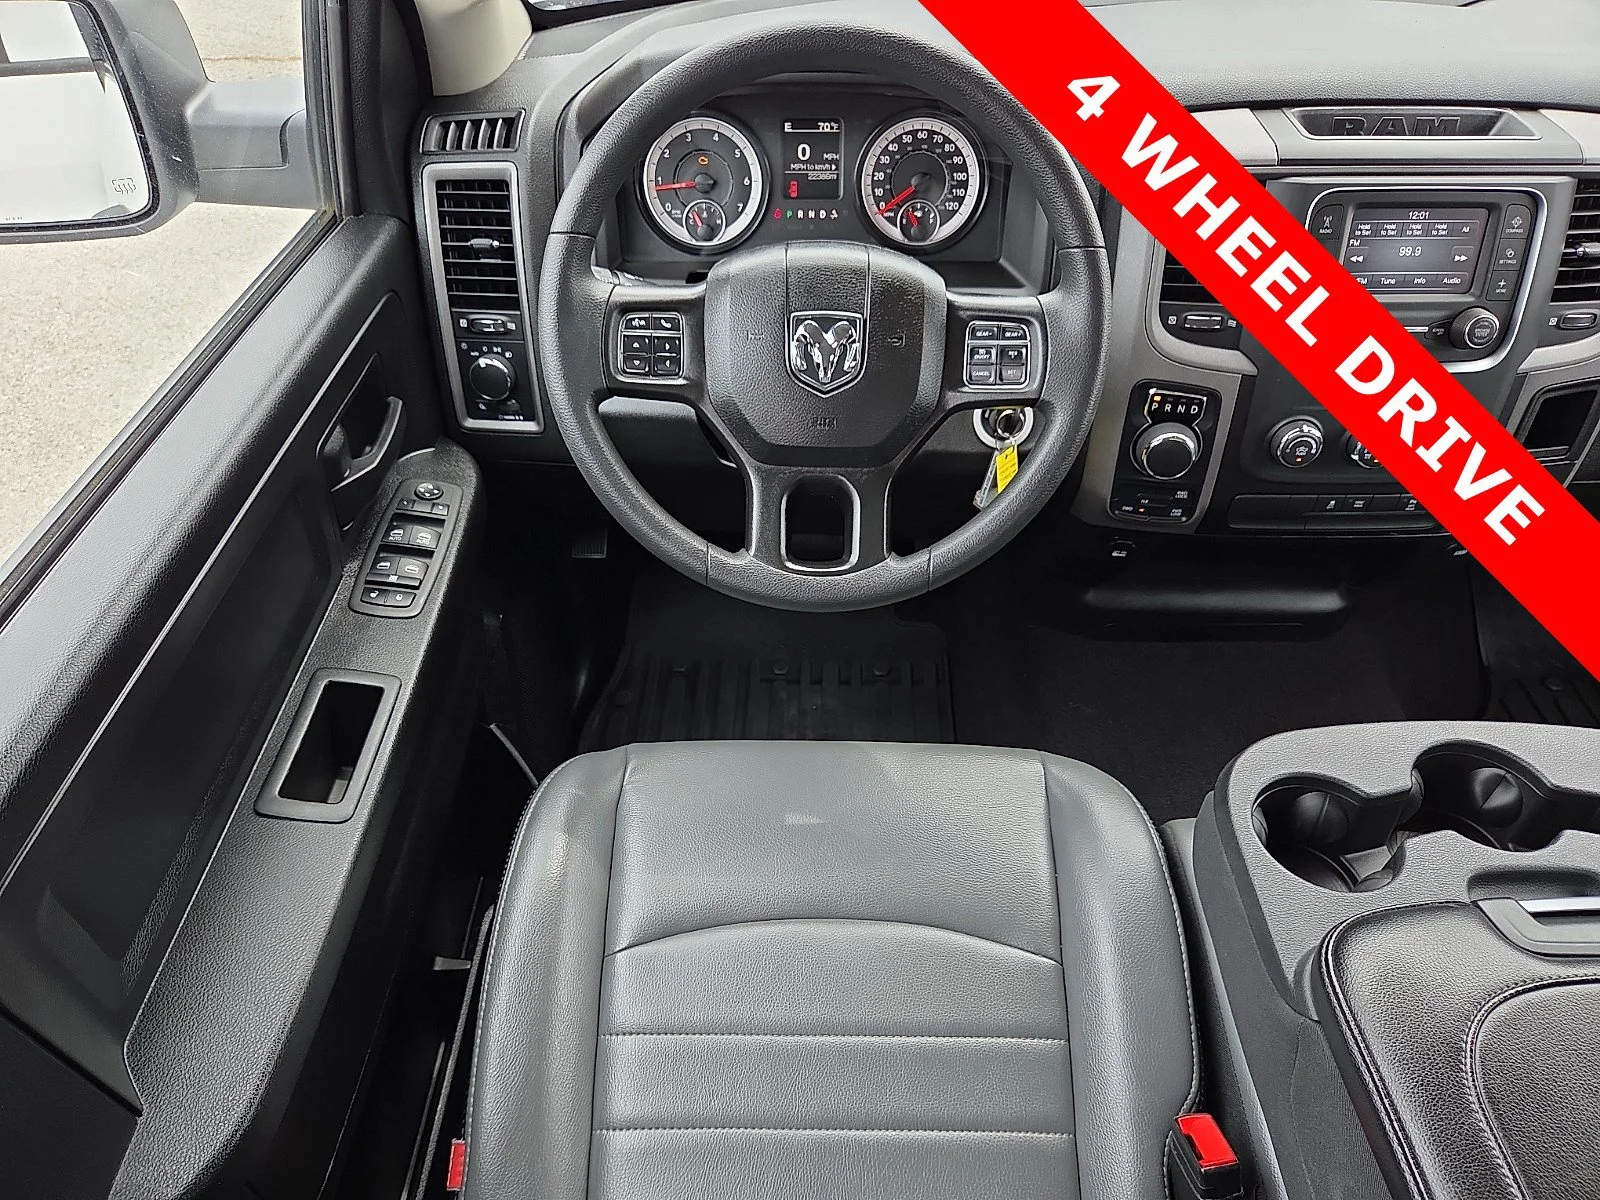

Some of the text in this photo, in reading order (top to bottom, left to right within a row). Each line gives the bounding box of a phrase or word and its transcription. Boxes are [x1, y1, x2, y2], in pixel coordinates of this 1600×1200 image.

[784, 122, 792, 132] E
[1331, 116, 1460, 137] RAM
[685, 133, 692, 142] 3
[712, 133, 719, 142] 4
[902, 134, 913, 143] 50
[917, 130, 928, 139] 60
[932, 134, 943, 144] 70
[797, 143, 840, 161] 0 MPH
[887, 143, 899, 152] 40
[944, 143, 956, 152] 80
[663, 149, 670, 158] 2
[734, 149, 741, 158] 5
[879, 155, 890, 164] 30
[952, 156, 963, 164] 90
[790, 163, 831, 171] MPH to km/h
[657, 176, 662, 184] 1
[873, 172, 885, 180] 20
[953, 172, 967, 181] 100
[743, 176, 750, 186] 6
[874, 188, 883, 197] 10
[952, 188, 965, 197] 110
[665, 202, 672, 212] 0
[737, 203, 743, 212] 7
[879, 201, 885, 210] 0
[945, 202, 959, 211] 120
[786, 209, 827, 219] P R N D
[1408, 211, 1430, 220] 12:01
[1398, 246, 1422, 257] 99.9
[1380, 277, 1396, 285] Tune
[1413, 277, 1426, 285] Info
[1151, 402, 1199, 415] P R N D
